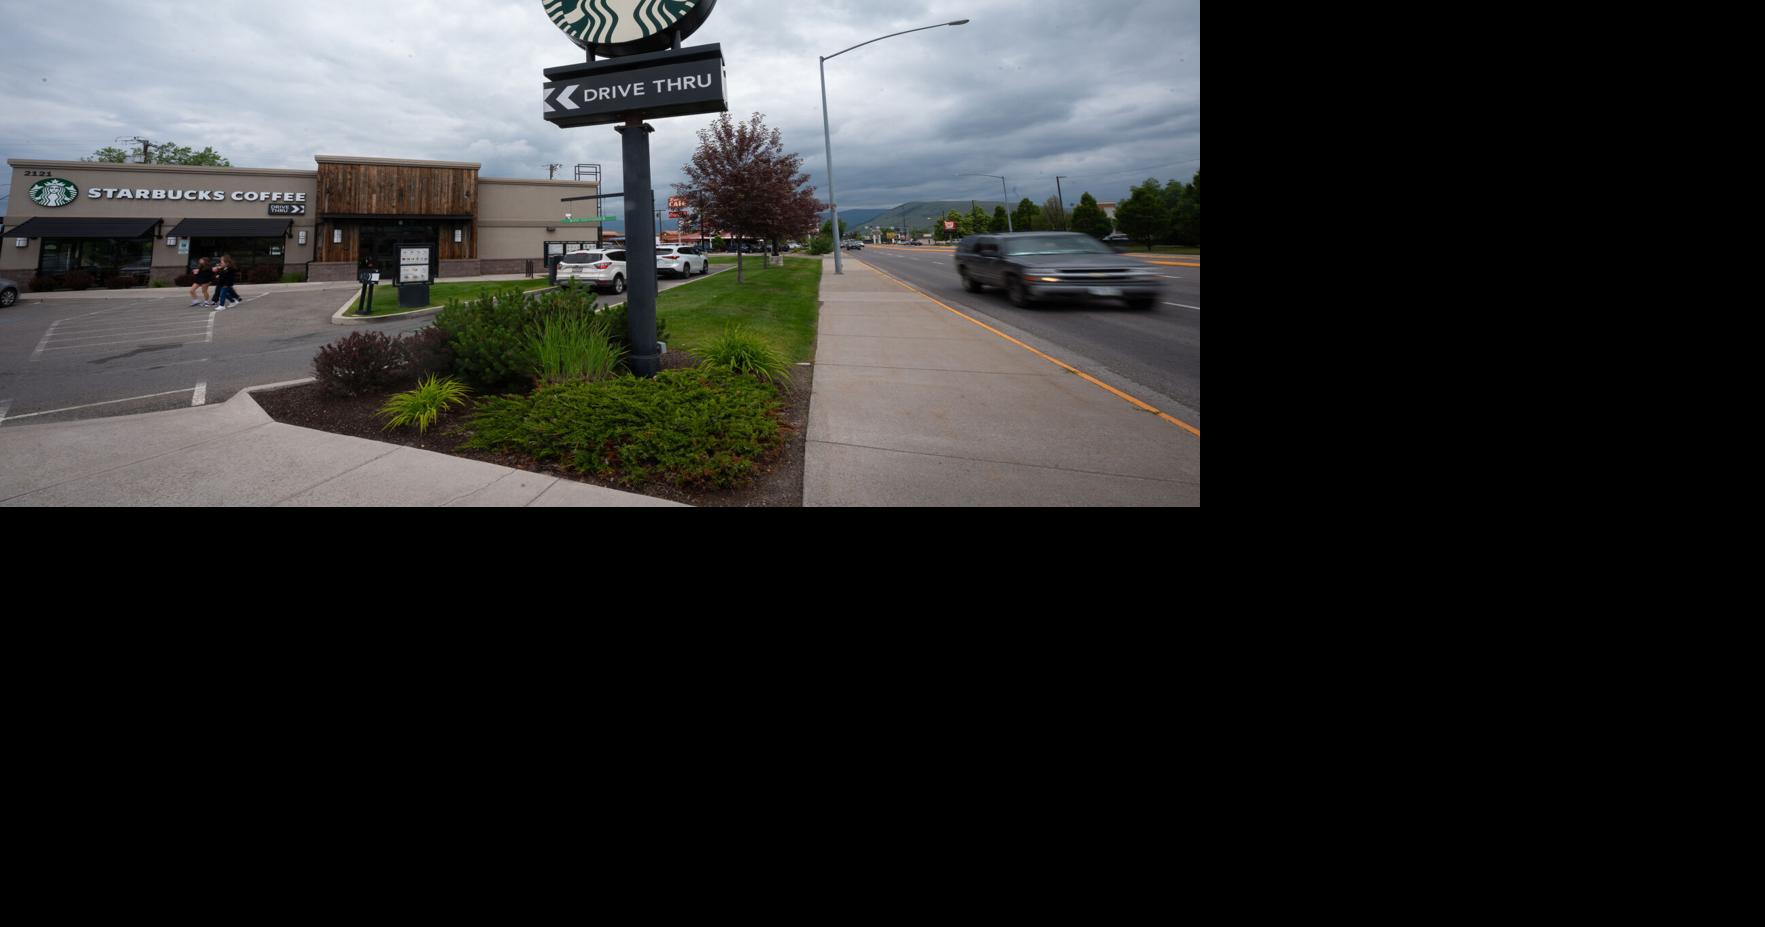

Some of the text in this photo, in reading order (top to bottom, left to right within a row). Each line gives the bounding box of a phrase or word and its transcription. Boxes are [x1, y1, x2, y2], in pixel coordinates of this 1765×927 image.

[583, 73, 712, 102] DRIVE THRU
[87, 187, 306, 202] STARBUCKS COFFEE
